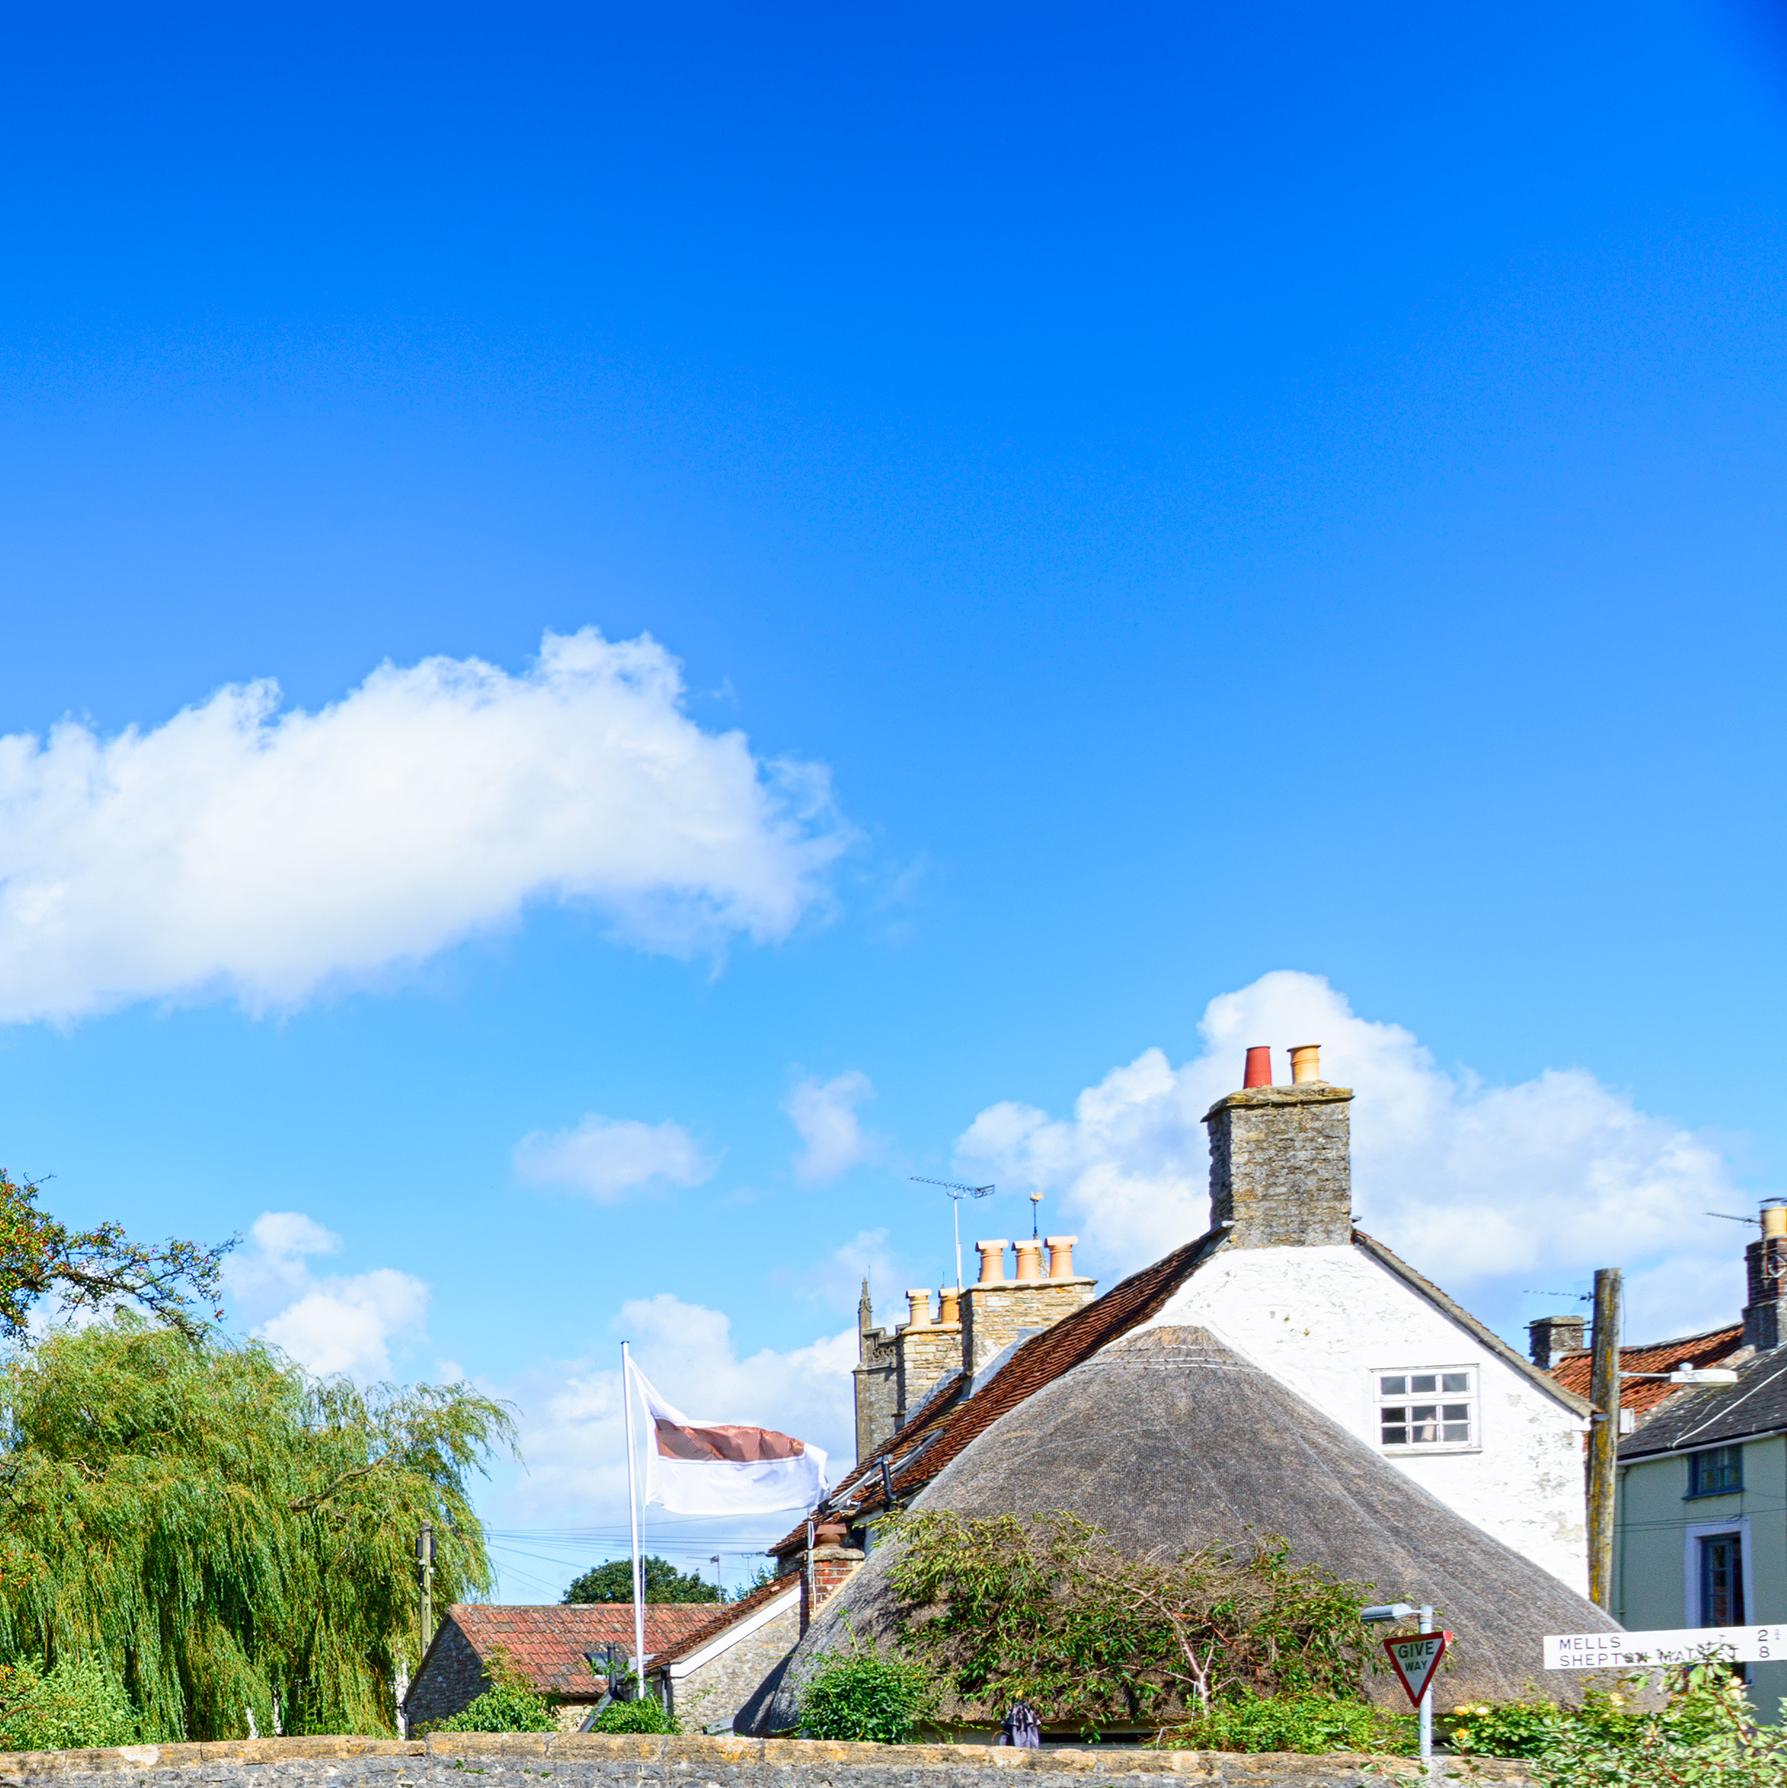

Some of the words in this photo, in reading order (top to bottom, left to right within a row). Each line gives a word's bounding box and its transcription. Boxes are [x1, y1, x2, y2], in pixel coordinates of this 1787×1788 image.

[1559, 1636, 1621, 1650] MELLS
[1398, 1641, 1434, 1659] GIVE
[1759, 1646, 1770, 1658] 8
[1404, 1660, 1428, 1672] WAY
